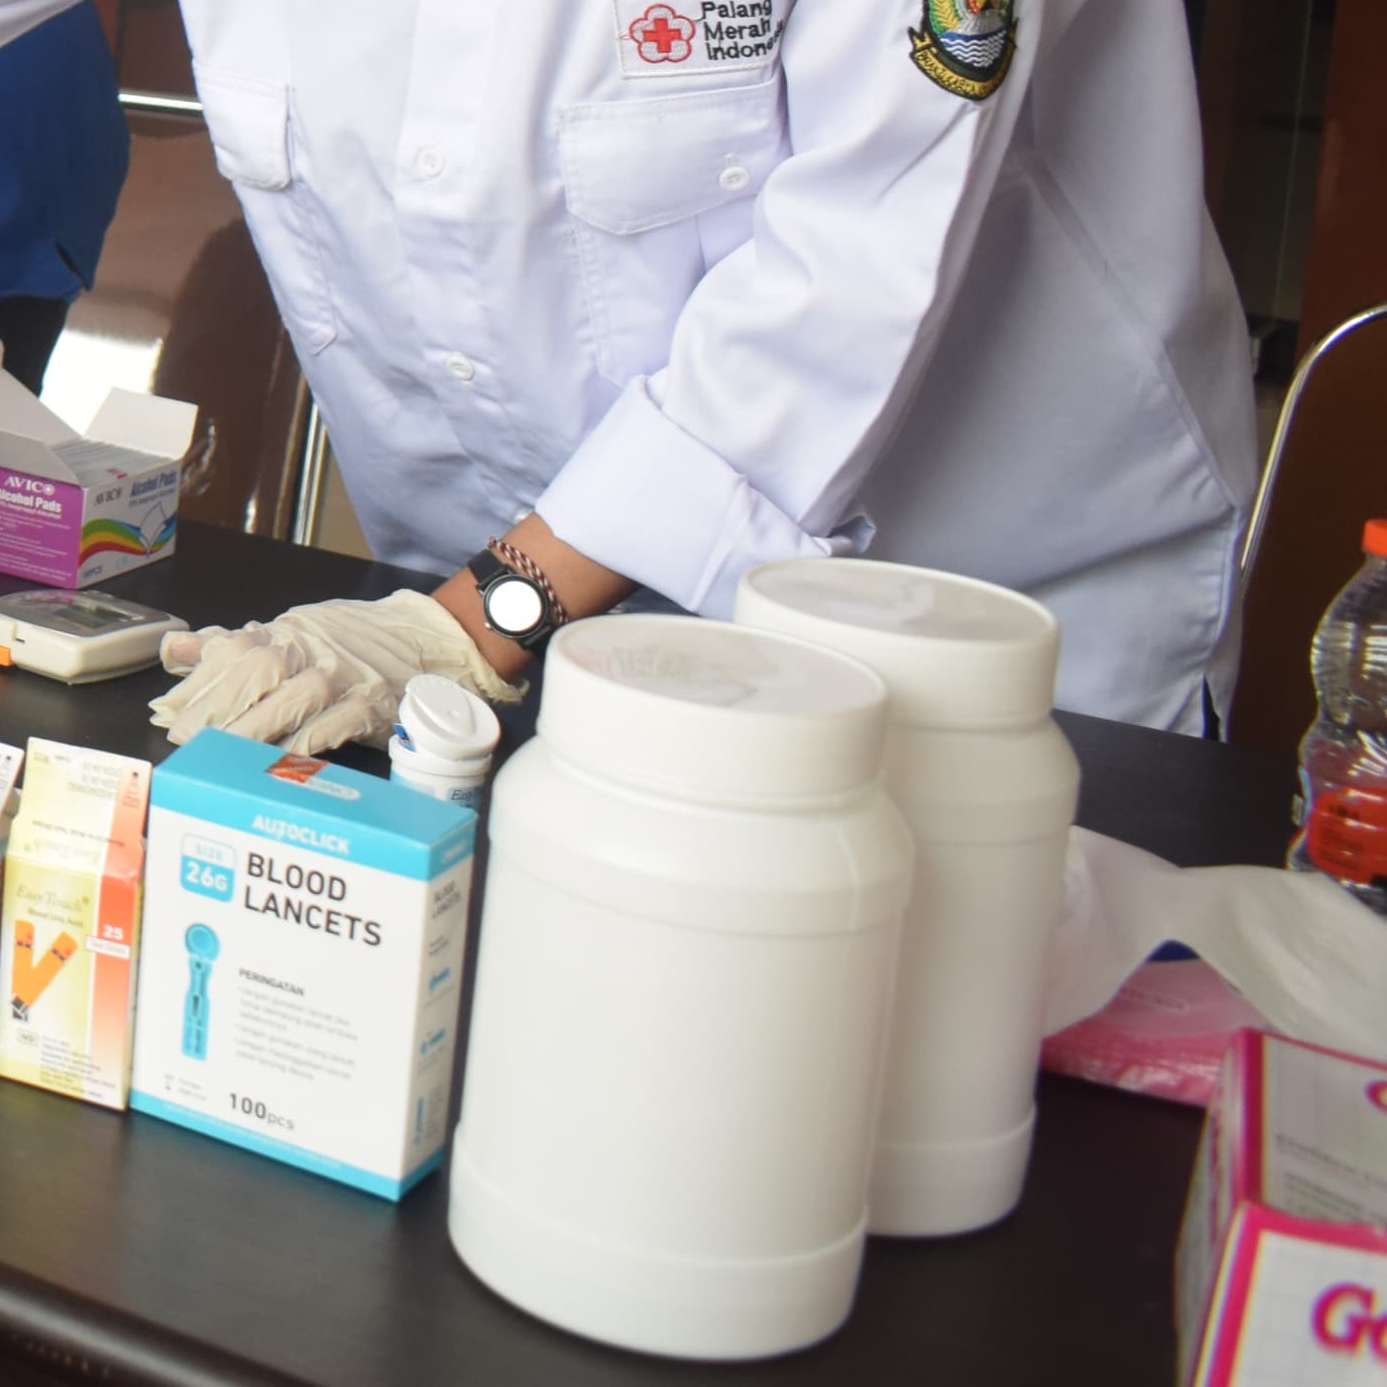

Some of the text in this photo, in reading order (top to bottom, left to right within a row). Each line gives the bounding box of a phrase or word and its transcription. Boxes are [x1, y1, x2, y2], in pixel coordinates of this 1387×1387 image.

[703, 17, 771, 41] Merah
[4, 476, 55, 496] AVICO
[35, 497, 62, 514] Pads
[252, 814, 350, 854] AUTOCLICK
[186, 860, 228, 893] 26G
[246, 851, 347, 902] BLOOD
[243, 884, 382, 946] LANCETS
[103, 923, 124, 941] 25
